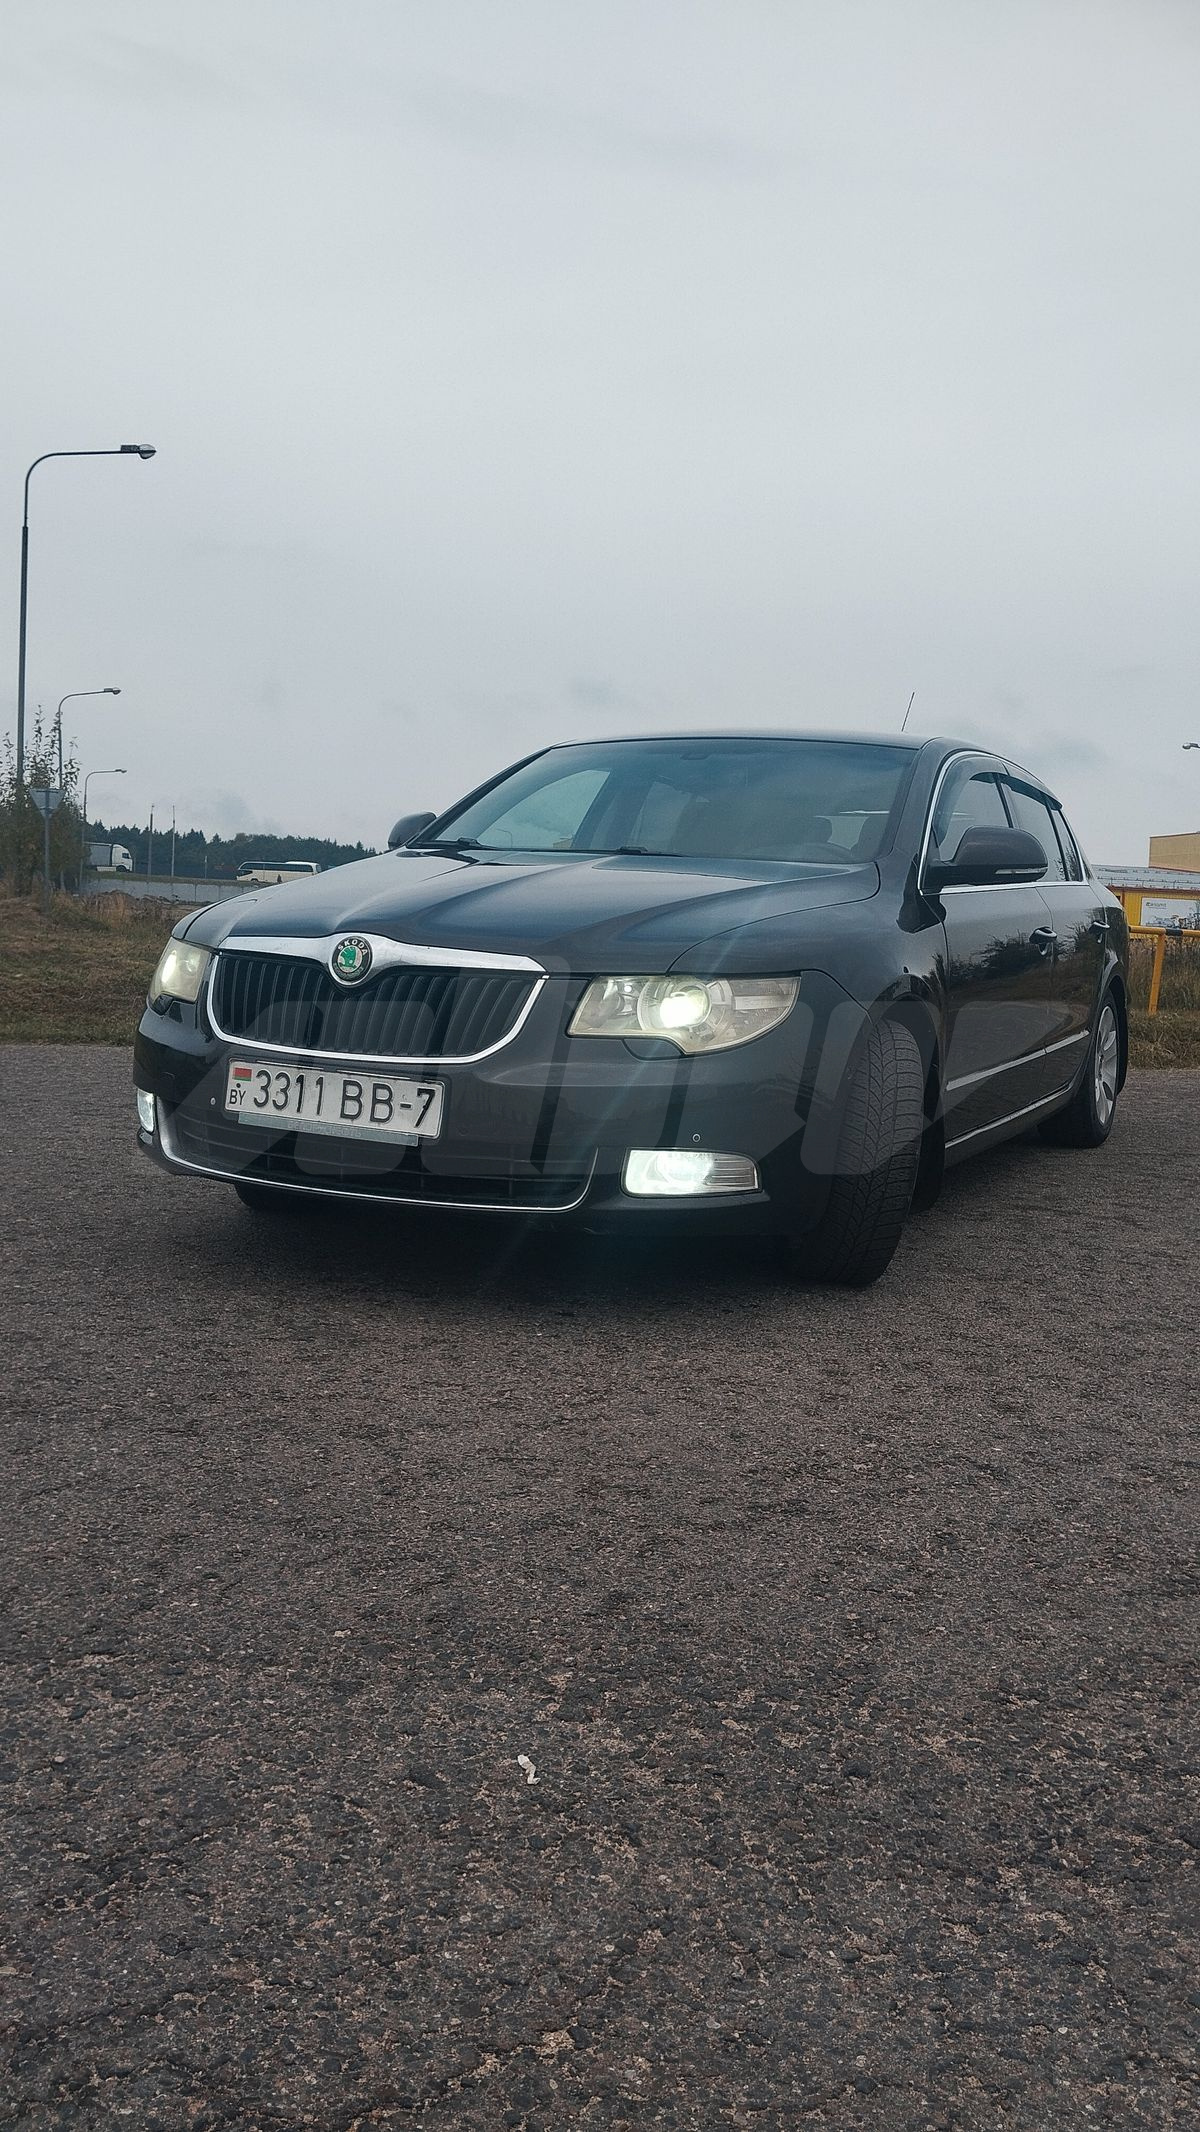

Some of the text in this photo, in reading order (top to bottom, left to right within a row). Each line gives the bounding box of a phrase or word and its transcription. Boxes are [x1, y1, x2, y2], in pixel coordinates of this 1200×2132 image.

[229, 1088, 246, 1106] BY
[253, 1069, 436, 1128] 3311 BB-7
